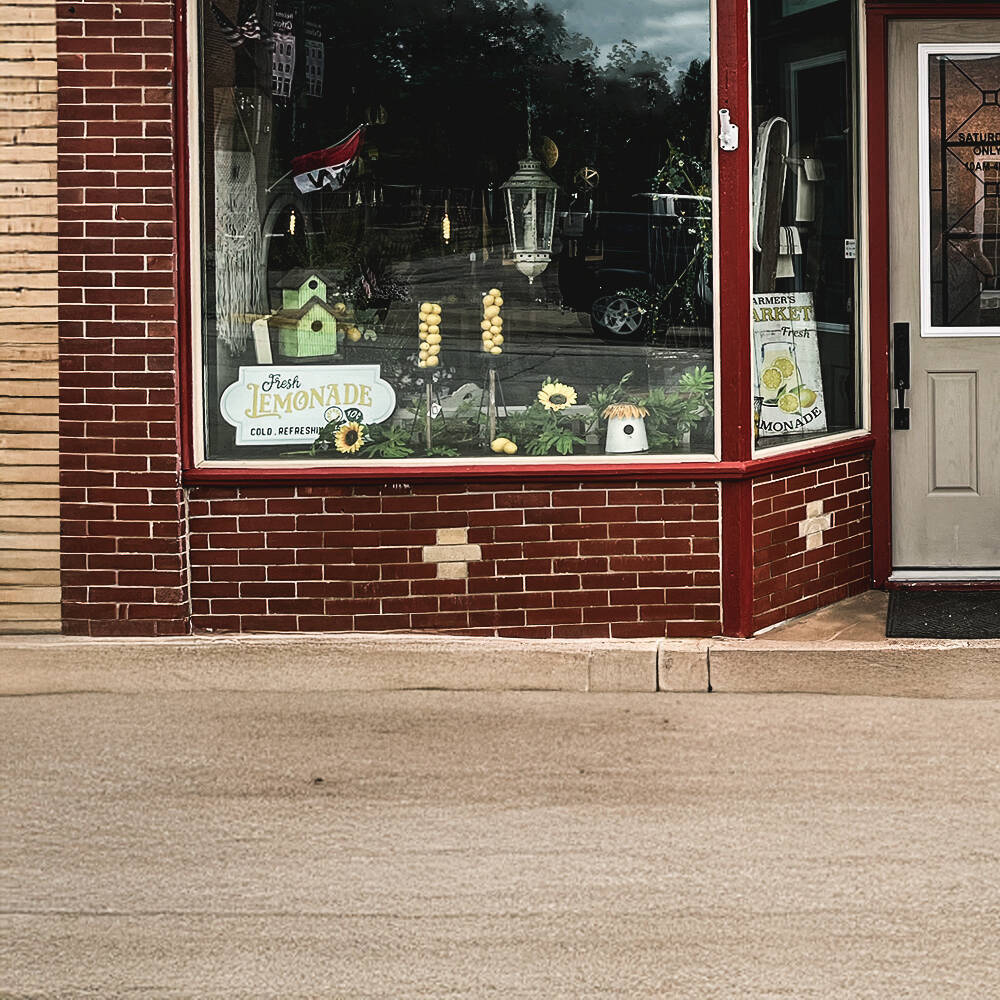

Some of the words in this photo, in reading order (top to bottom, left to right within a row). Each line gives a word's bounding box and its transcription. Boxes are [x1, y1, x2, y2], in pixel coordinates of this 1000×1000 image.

[973, 145, 1000, 156] ONLY
[781, 326, 810, 338] Fresh
[262, 374, 301, 391] Fresh
[245, 383, 372, 419] LEMONADE
